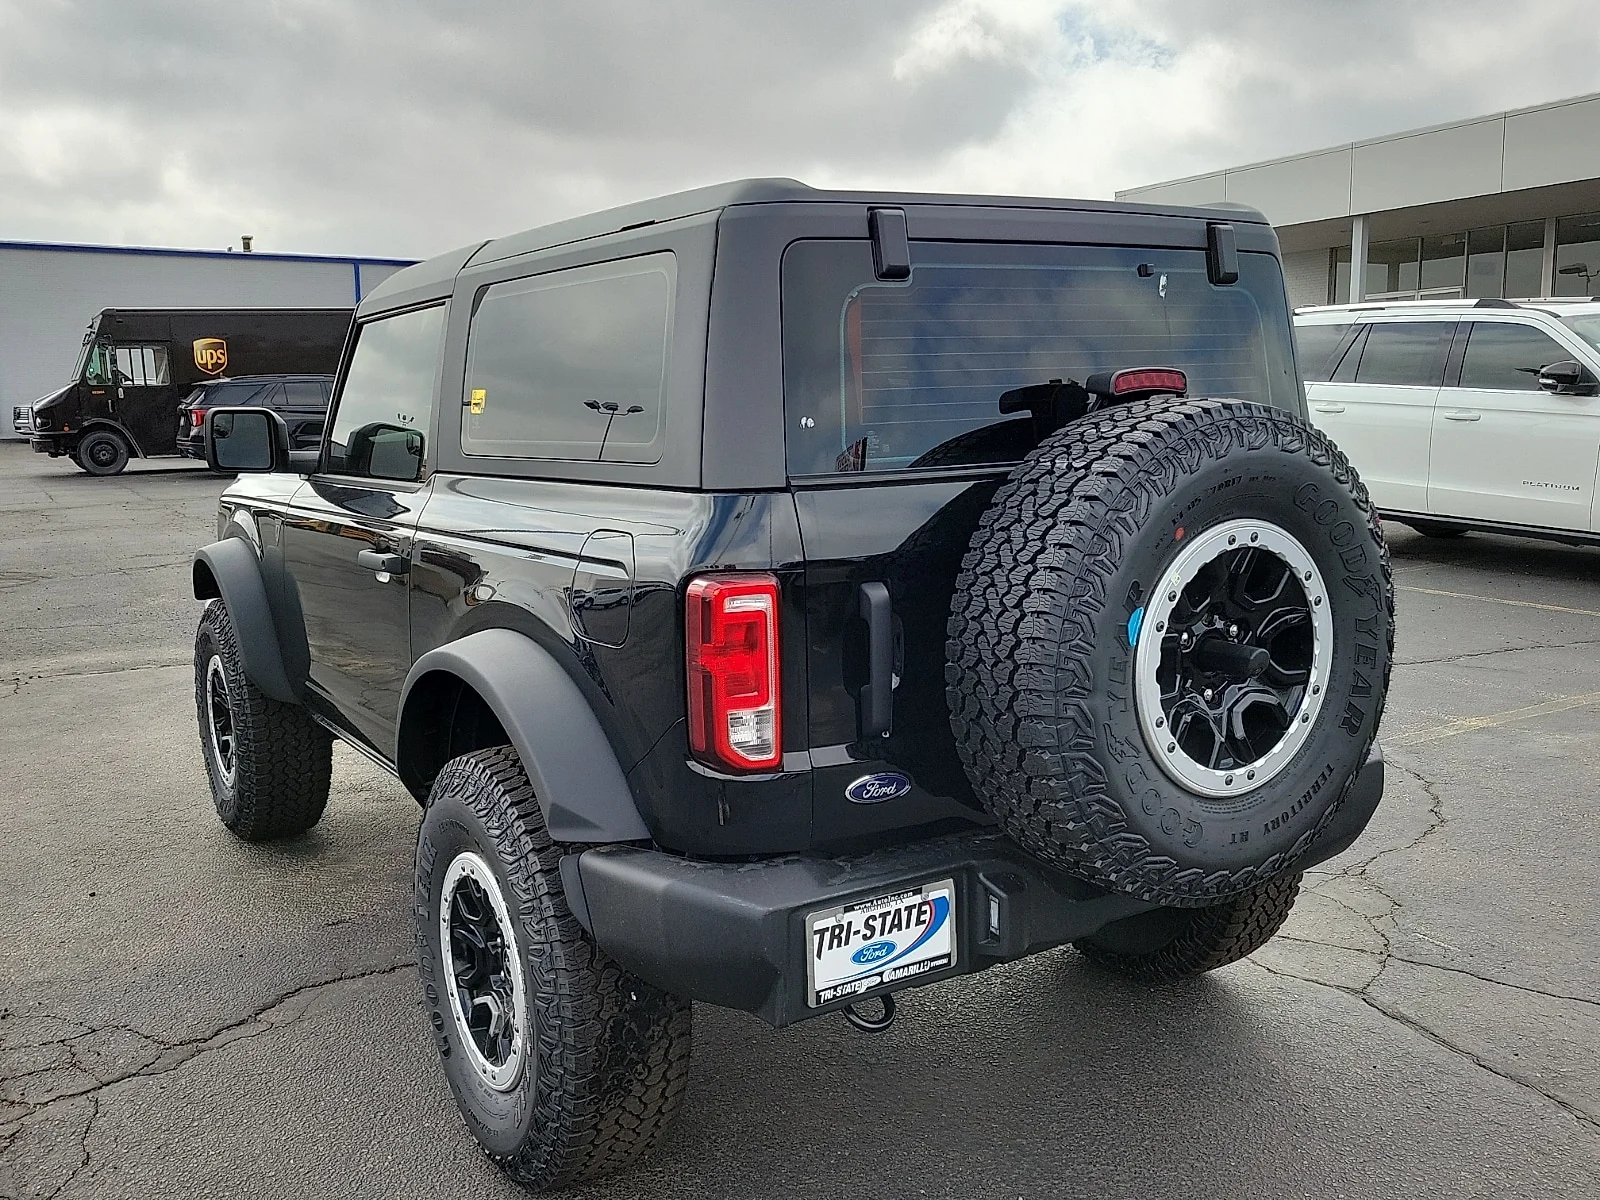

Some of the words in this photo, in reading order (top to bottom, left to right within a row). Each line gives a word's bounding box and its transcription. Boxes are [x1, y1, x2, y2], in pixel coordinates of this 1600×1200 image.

[197, 349, 226, 369] ups
[1521, 480, 1580, 491] PLATINUM
[862, 779, 898, 799] Ford
[1262, 762, 1336, 836] TERRITORY
[813, 900, 929, 960] TRI-STATE
[860, 944, 888, 962] Ford
[818, 980, 862, 1004] TRI-STATE
